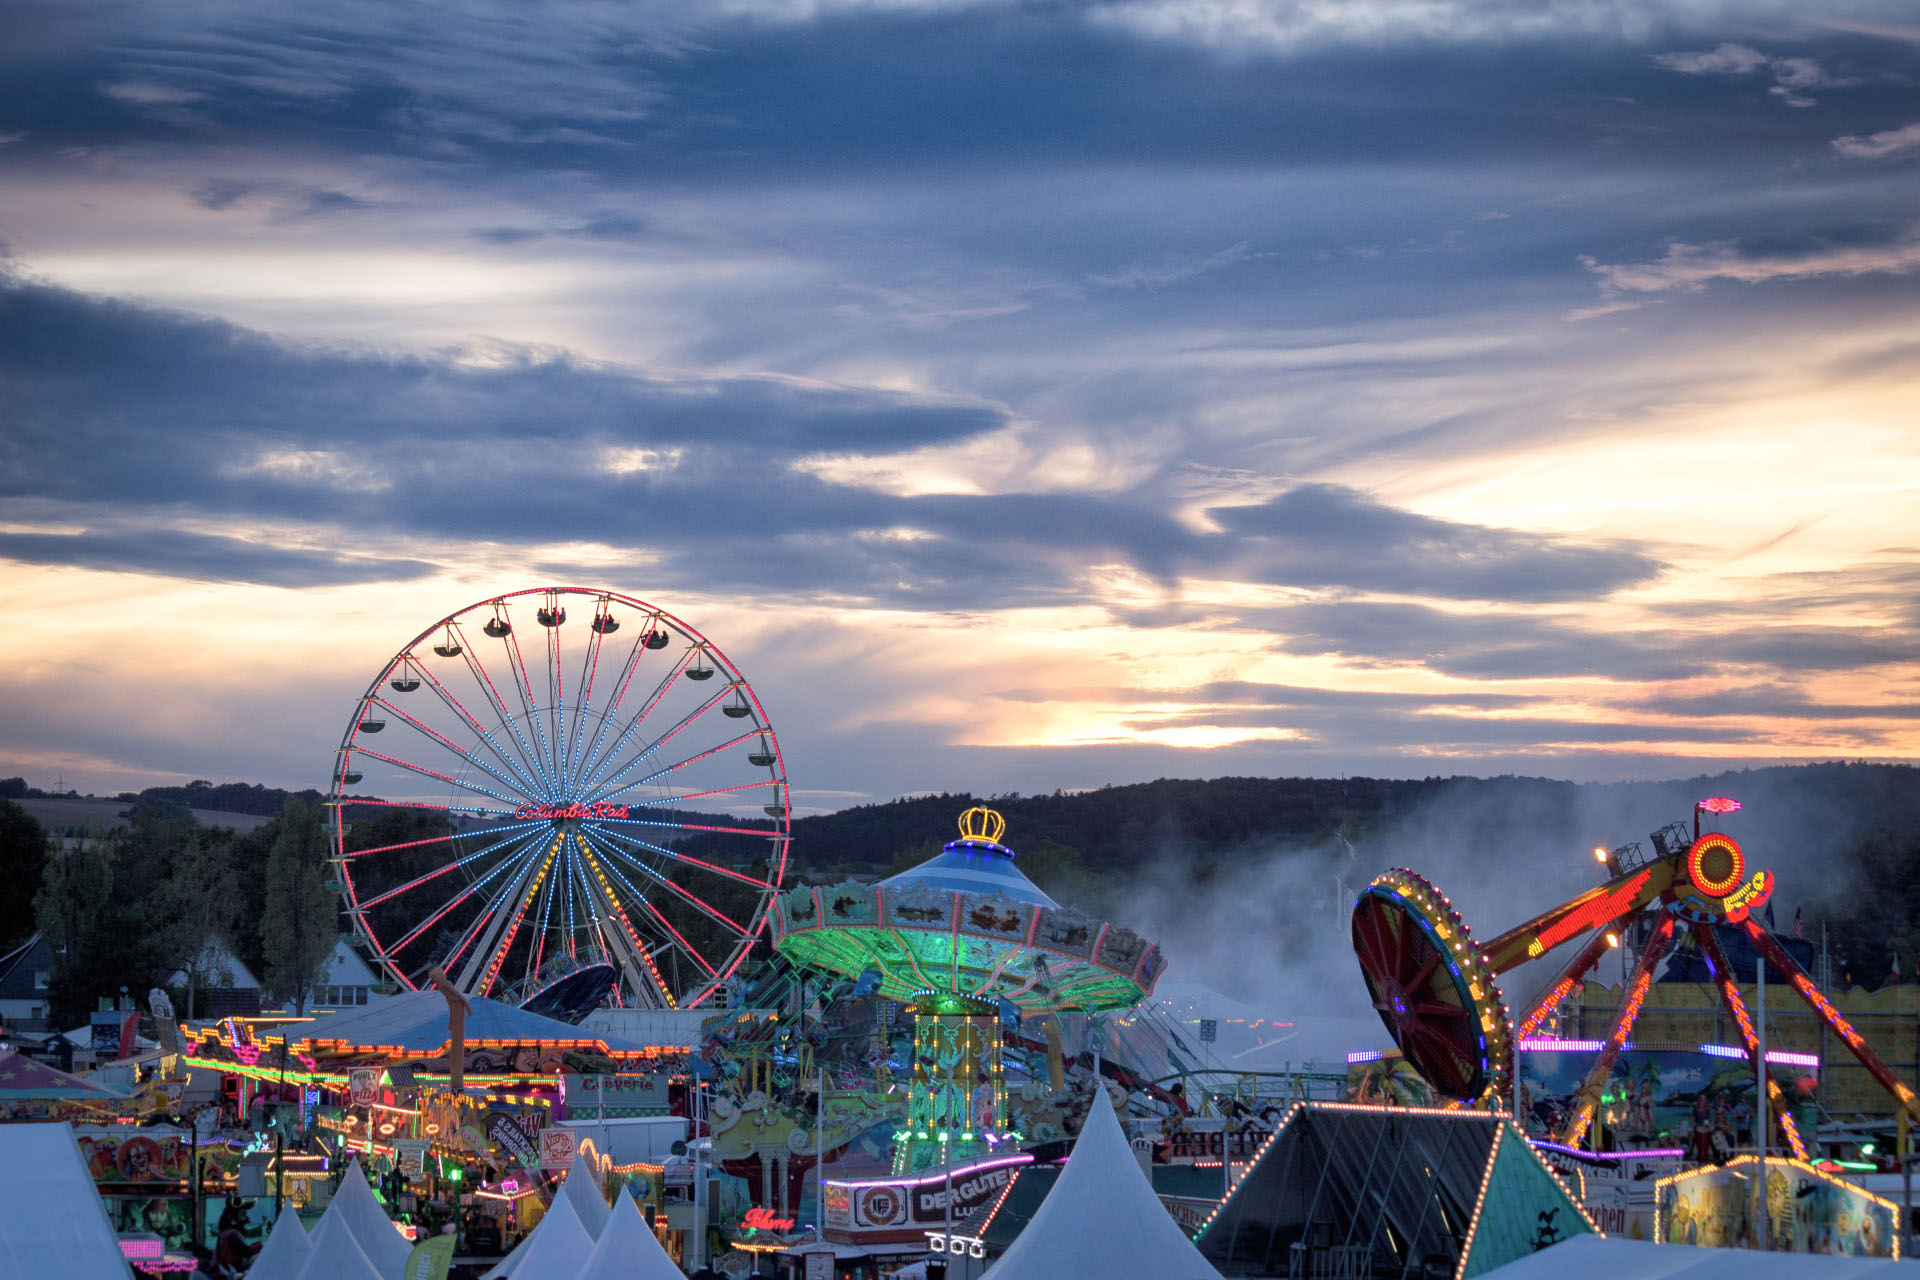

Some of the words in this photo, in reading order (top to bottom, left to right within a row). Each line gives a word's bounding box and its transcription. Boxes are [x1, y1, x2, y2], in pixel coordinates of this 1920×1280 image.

[515, 801, 592, 819] Columbia
[592, 800, 630, 819] Rad
[354, 1090, 377, 1101] PIZZA
[549, 1149, 564, 1160] Co
[920, 1188, 961, 1211] DER
[959, 1169, 1009, 1200] GUTE
